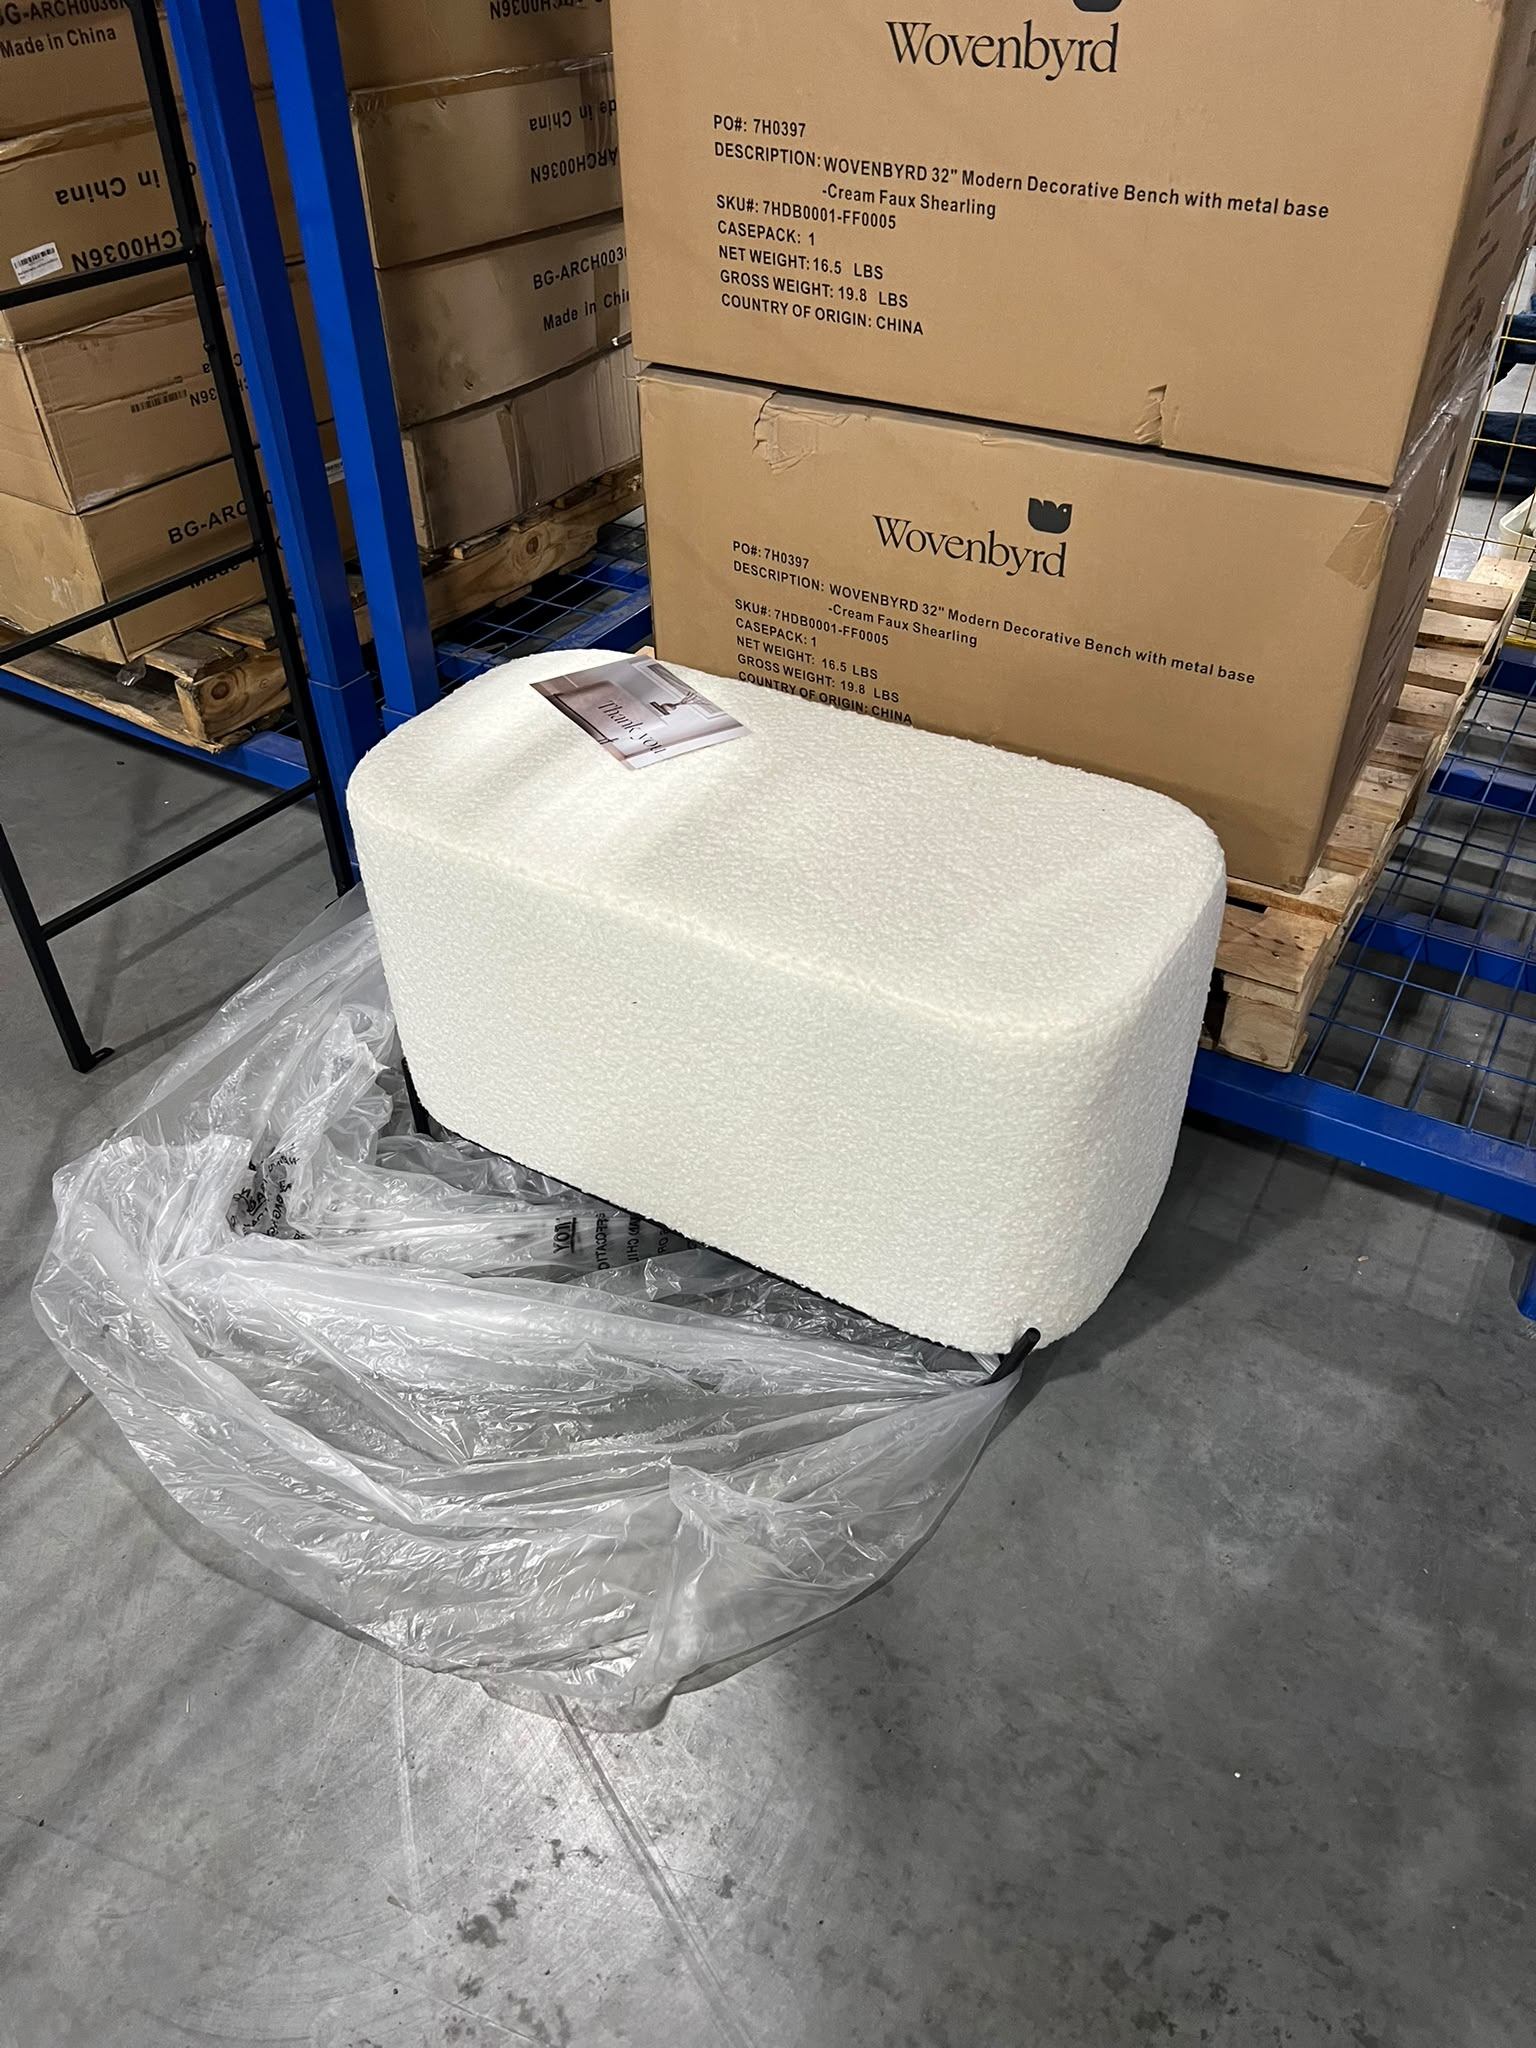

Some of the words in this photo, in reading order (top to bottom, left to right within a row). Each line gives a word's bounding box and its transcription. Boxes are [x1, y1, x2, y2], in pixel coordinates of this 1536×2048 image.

[0, 37, 45, 59] Made
[47, 33, 64, 50] in
[67, 27, 117, 47] China
[885, 19, 1120, 81] Wovenbyrd
[529, 110, 572, 131] China
[713, 114, 748, 132] PO#:
[753, 118, 806, 138] 7H0397
[138, 169, 160, 189] in
[531, 147, 618, 185] ARCH0036N
[714, 141, 821, 168] DESCRIPTION:
[824, 157, 927, 182] WOVENBYRD
[931, 167, 957, 184] 32"
[962, 170, 1022, 190] Modern
[1027, 176, 1118, 200] Decorative
[1124, 184, 1179, 205] Bench
[1184, 191, 1222, 209] with
[1227, 197, 1279, 215] metal
[1284, 199, 1329, 218] base
[55, 176, 126, 206] China
[822, 183, 875, 204] -Cream
[879, 190, 915, 208] Faux
[920, 194, 996, 219] Shearling
[716, 194, 759, 213] SKU#:
[763, 200, 897, 229] 7HDB0001-FF0005
[717, 220, 801, 244] CASEPACK:
[809, 232, 815, 246] 1
[533, 246, 627, 290] BG-ARCH003
[718, 245, 746, 261] NET
[749, 248, 810, 271] WEIGHT:
[812, 257, 842, 274] 16.5
[853, 262, 883, 280] LBS
[720, 269, 769, 289] GROSS
[773, 277, 834, 298] WEIGHT:
[837, 285, 867, 302] 19.8
[878, 291, 908, 308] LBS
[543, 307, 577, 331] Made
[585, 301, 597, 316] in
[721, 293, 788, 316] COUNTRY
[792, 304, 811, 318] OF
[814, 307, 872, 328] ORIGIN:
[876, 315, 924, 335] CHINA
[733, 540, 761, 558] PO#:
[764, 547, 810, 570] 7H0397
[872, 514, 1067, 578] Wovenbyrd
[733, 560, 825, 592] DESCRIPTION:
[829, 583, 919, 613] WOVENBYRD
[922, 603, 945, 617] 32"
[948, 608, 999, 631] Modern
[1003, 620, 1081, 648] Decorative
[1084, 637, 1132, 659] Bench
[1135, 648, 1167, 666] with
[1170, 655, 1214, 676] metal
[1217, 665, 1256, 684] base
[735, 598, 771, 618] SKU#:
[774, 608, 889, 646] 7HDB0001-FF0005
[735, 617, 807, 645] CASEPACK:
[810, 635, 816, 647] 1
[828, 604, 874, 623] -Cream
[877, 613, 909, 632] Faux
[912, 621, 978, 648] Shearling
[736, 635, 761, 651] NET
[763, 640, 815, 665] WEIGHT:
[822, 658, 847, 673] 16.5
[852, 664, 878, 680] LBS
[737, 653, 780, 674] GROSS
[783, 664, 835, 688] WEIGHT:
[840, 680, 866, 695] 19.8
[873, 687, 900, 703] LBS
[738, 671, 796, 695] COUNTRY
[799, 687, 816, 701] OF
[819, 691, 868, 713] ORIGIN:
[871, 705, 913, 725] CHINA
[597, 700, 643, 734] Thank
[630, 732, 666, 754] you
